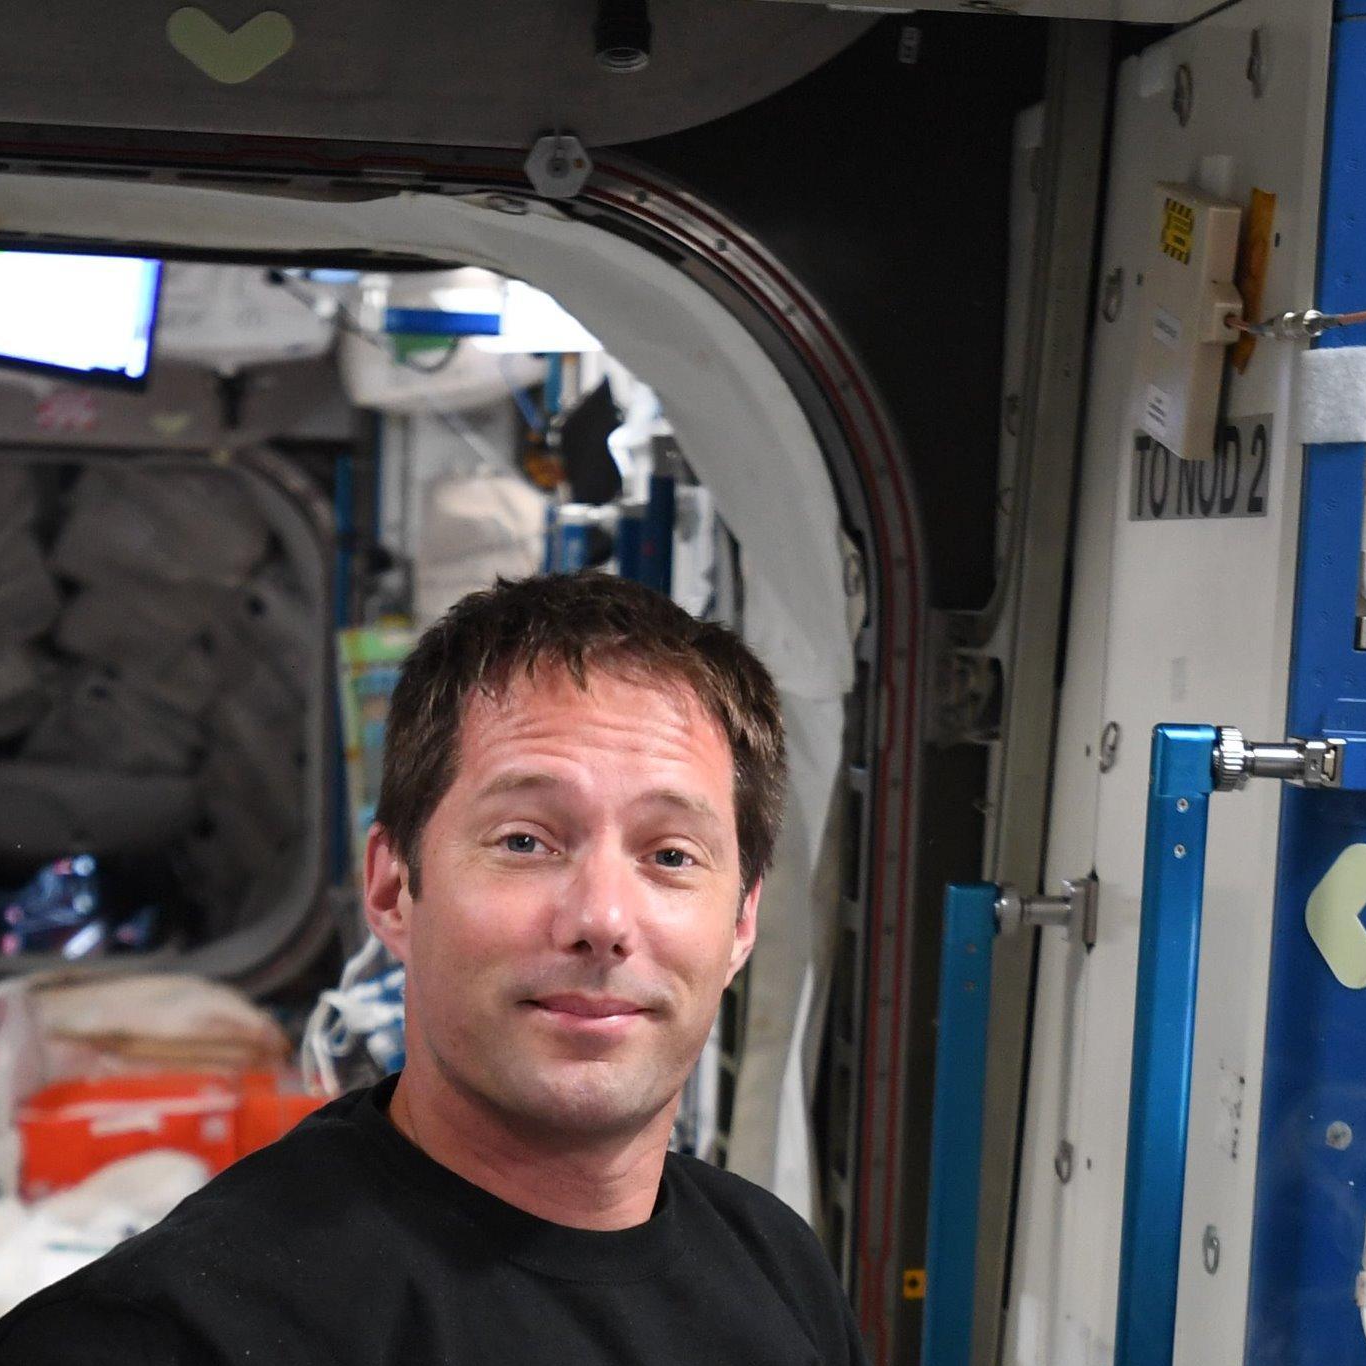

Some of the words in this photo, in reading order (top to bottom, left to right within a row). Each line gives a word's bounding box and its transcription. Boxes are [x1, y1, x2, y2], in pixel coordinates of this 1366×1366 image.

[1136, 436, 1169, 518] TO
[1176, 425, 1240, 518] NOD
[1247, 424, 1268, 513] 2
